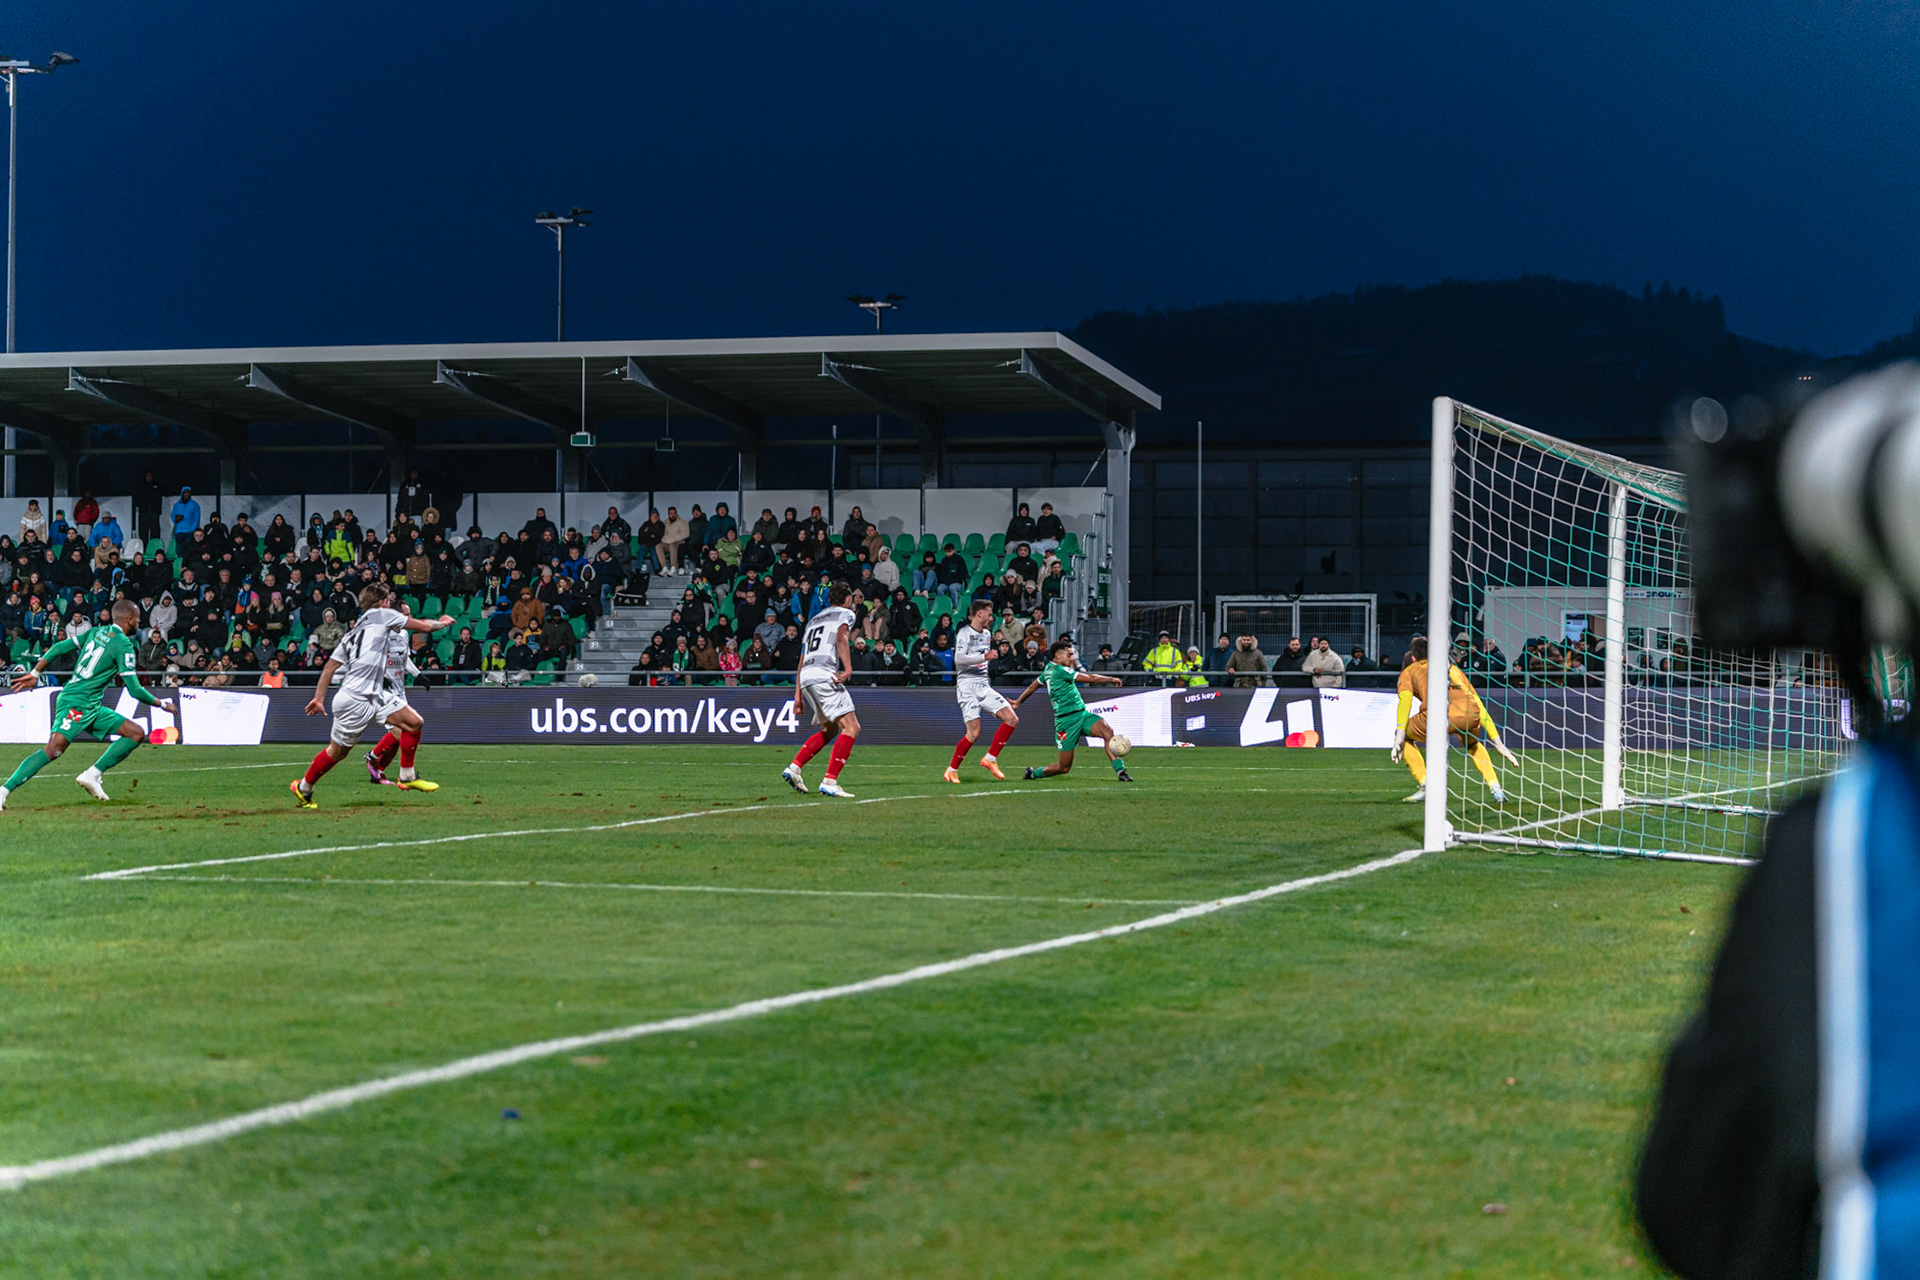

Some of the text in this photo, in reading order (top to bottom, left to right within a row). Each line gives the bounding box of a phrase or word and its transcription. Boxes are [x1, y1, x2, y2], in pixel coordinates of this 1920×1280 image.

[806, 626, 825, 655] 16
[75, 640, 105, 679] 21
[1184, 690, 1221, 703] UBS key4
[530, 698, 800, 743] ubs.com/key4
